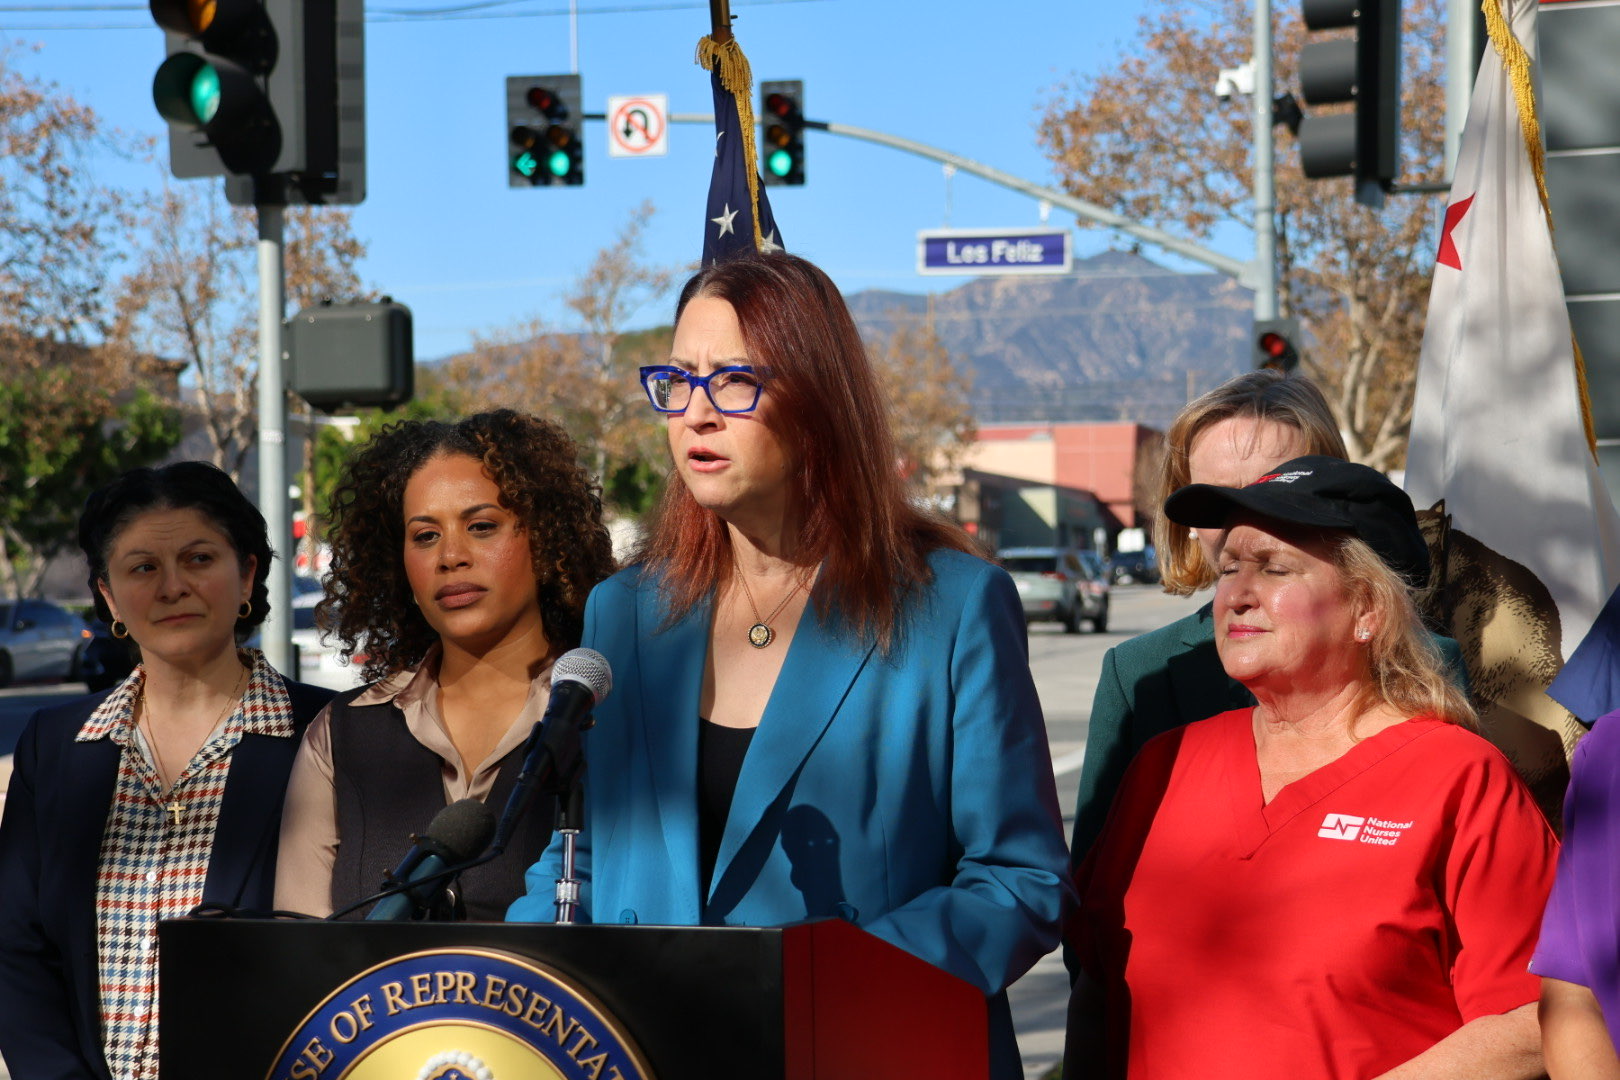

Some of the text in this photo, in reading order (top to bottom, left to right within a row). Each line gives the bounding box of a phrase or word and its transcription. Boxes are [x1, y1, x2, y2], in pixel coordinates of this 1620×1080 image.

[946, 239, 1044, 264] Los Feliz
[1367, 817, 1414, 829] National
[1363, 826, 1401, 837] Nurses
[1359, 834, 1397, 846] United
[330, 994, 374, 1043] OF
